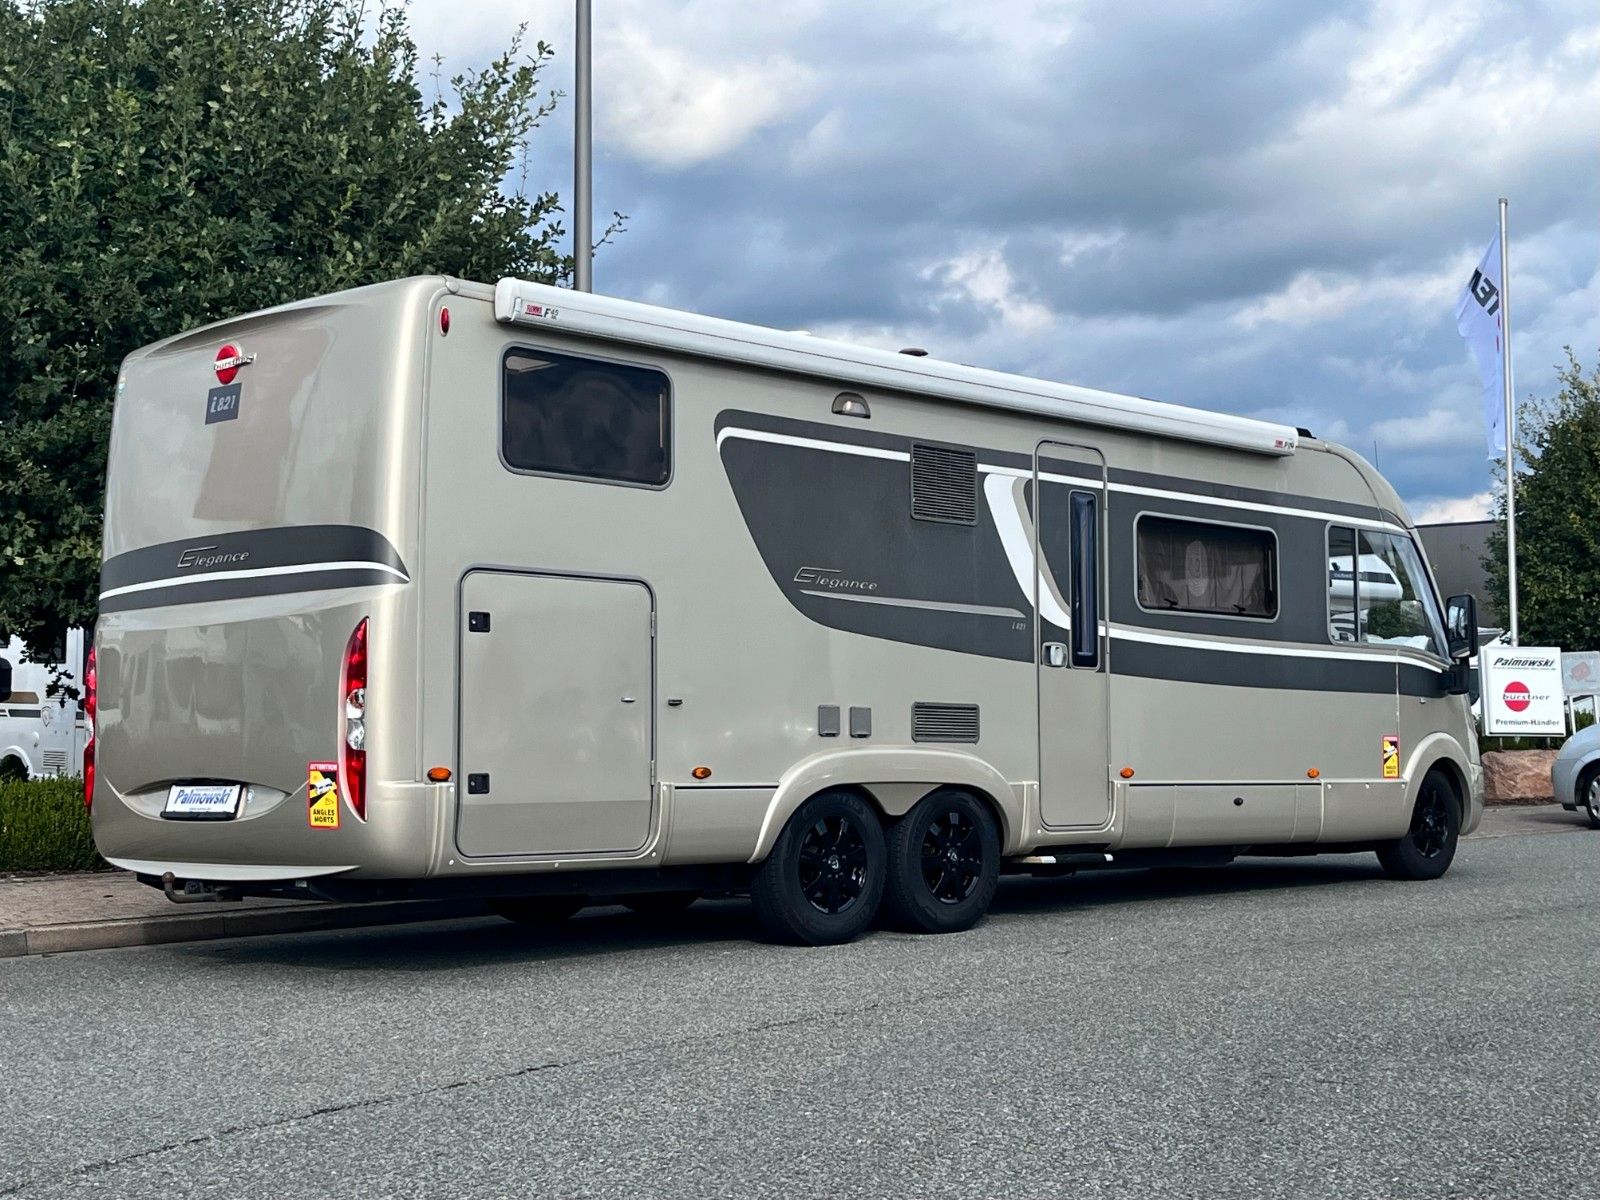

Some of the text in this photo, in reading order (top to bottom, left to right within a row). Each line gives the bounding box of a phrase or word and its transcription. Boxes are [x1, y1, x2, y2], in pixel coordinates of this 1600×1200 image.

[177, 545, 249, 567] Elegance
[793, 566, 878, 590] Elegance
[1493, 657, 1555, 668] Palmowski
[1503, 693, 1551, 701] bürstner
[174, 788, 233, 805] Palmowski
[313, 808, 335, 816] ANGLES
